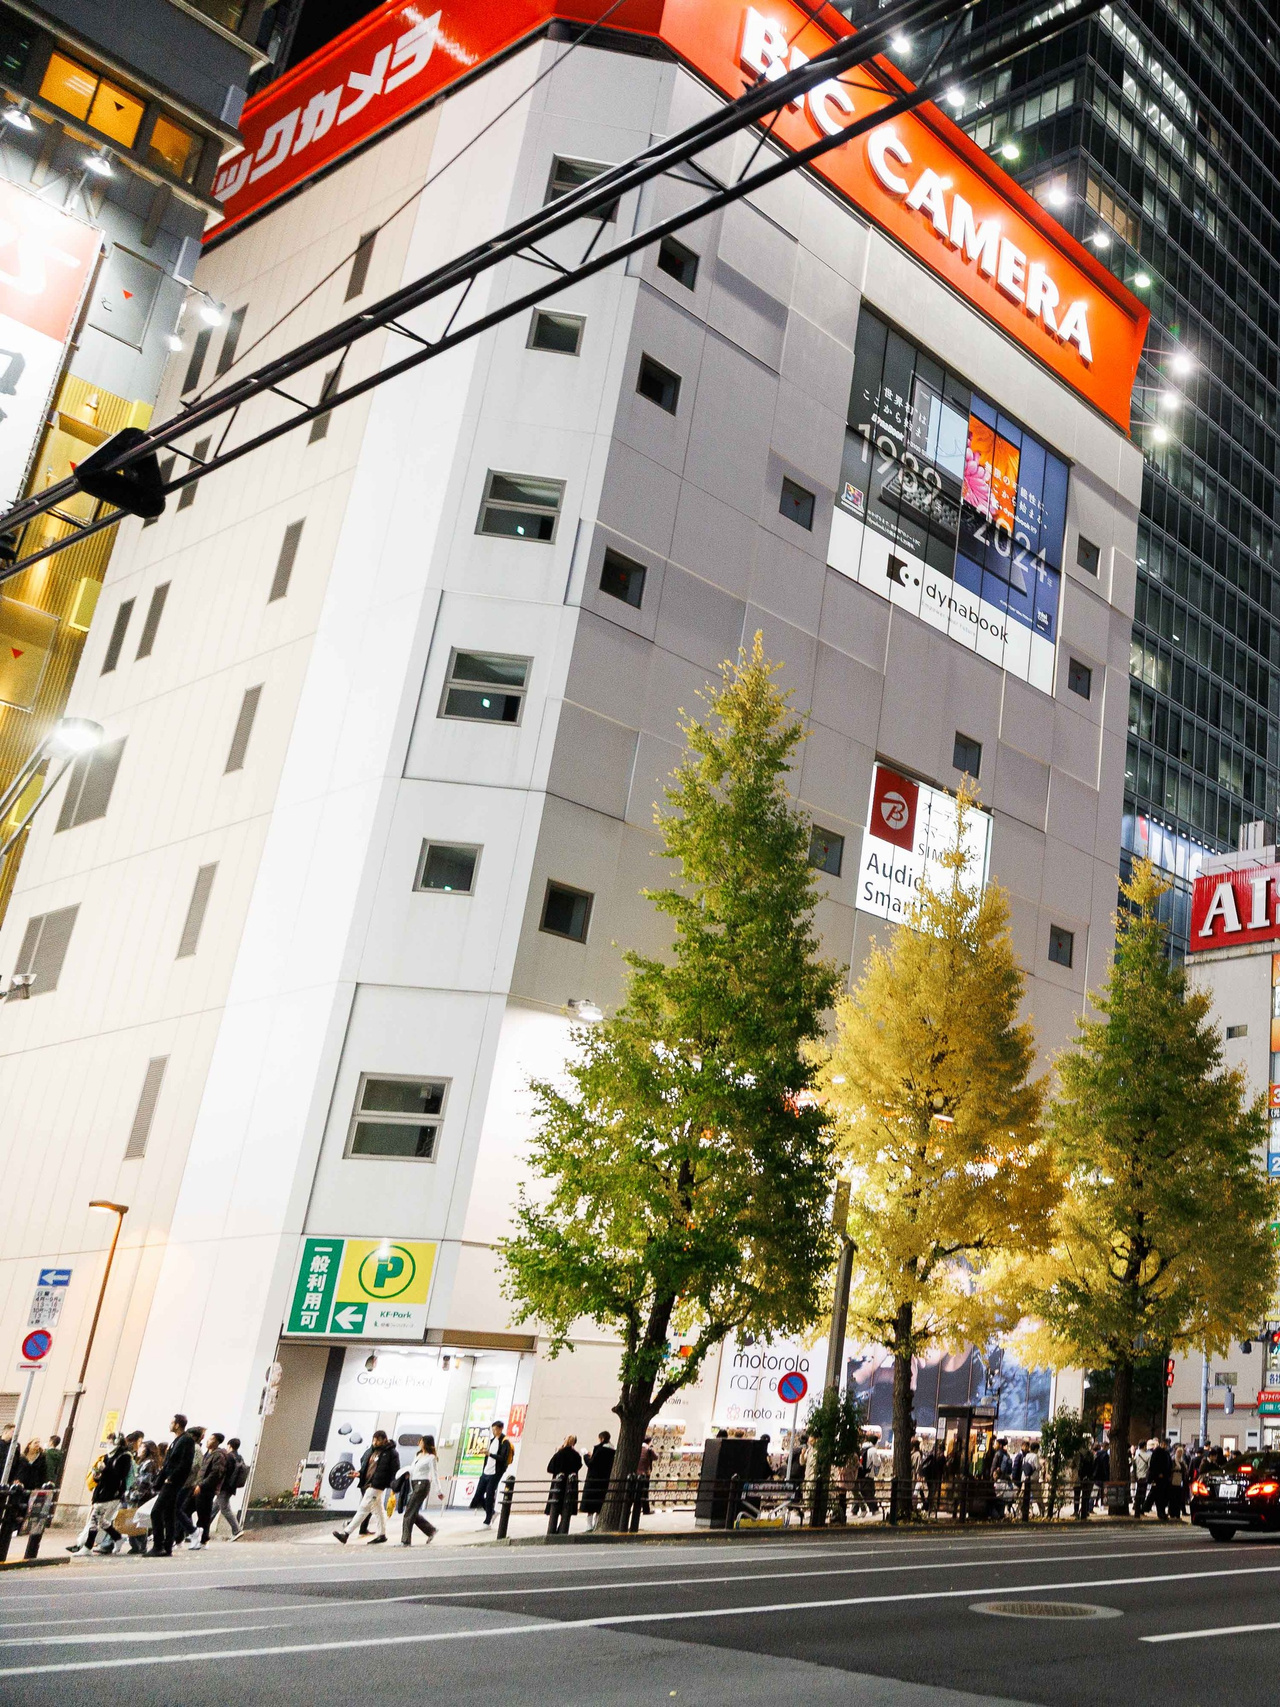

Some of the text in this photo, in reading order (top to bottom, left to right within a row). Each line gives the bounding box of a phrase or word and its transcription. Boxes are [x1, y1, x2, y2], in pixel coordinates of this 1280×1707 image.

[214, 9, 441, 202] ックカメラ
[742, 5, 1093, 364] BIC CAMERA
[926, 583, 1009, 644] dynabook
[300, 1246, 333, 1329] 一般利用可
[356, 1371, 401, 1390] Google
[730, 1374, 767, 1392] razr
[733, 1352, 810, 1373] motorola
[743, 1407, 786, 1420] moto ai
